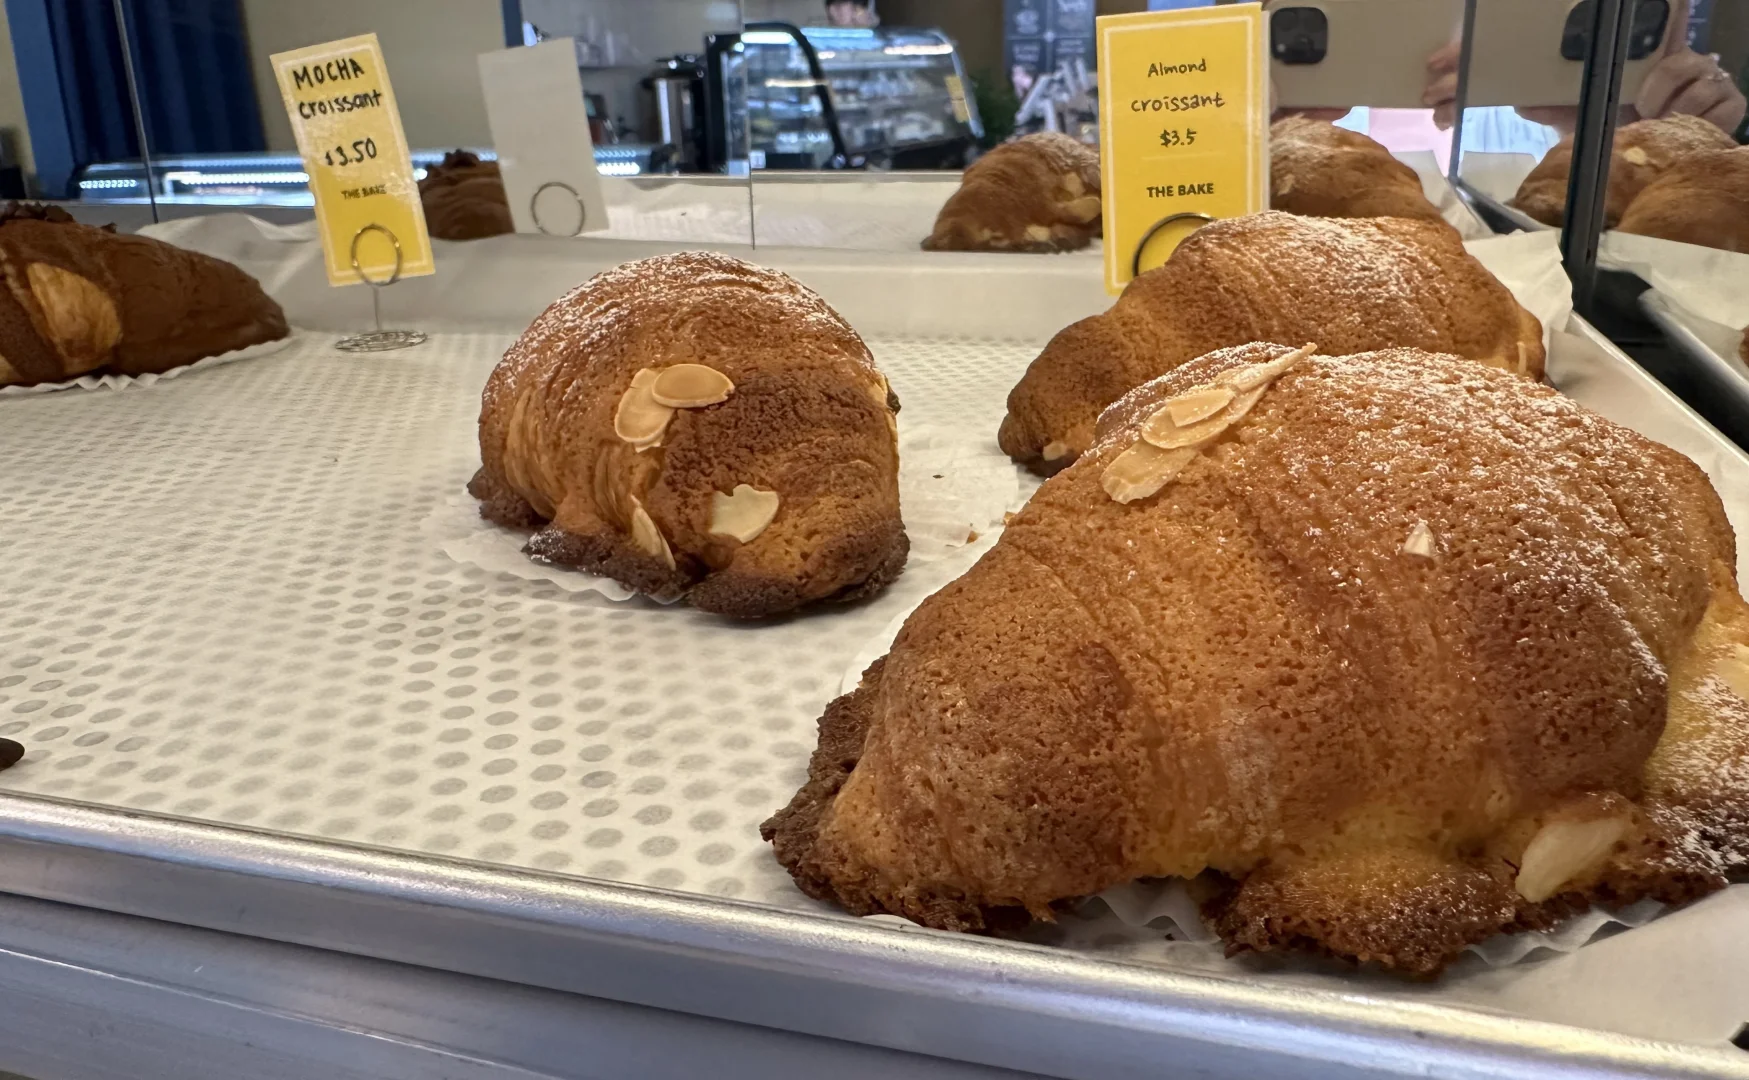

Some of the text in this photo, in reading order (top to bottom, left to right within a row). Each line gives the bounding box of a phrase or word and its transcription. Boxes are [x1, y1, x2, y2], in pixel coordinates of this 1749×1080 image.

[293, 58, 365, 90] MOCHA
[1147, 58, 1207, 77] Almond
[1131, 92, 1226, 112] croissant
[1160, 129, 1197, 147] $3.5
[341, 188, 361, 201] THE
[1146, 182, 1214, 198] THE BAKE
